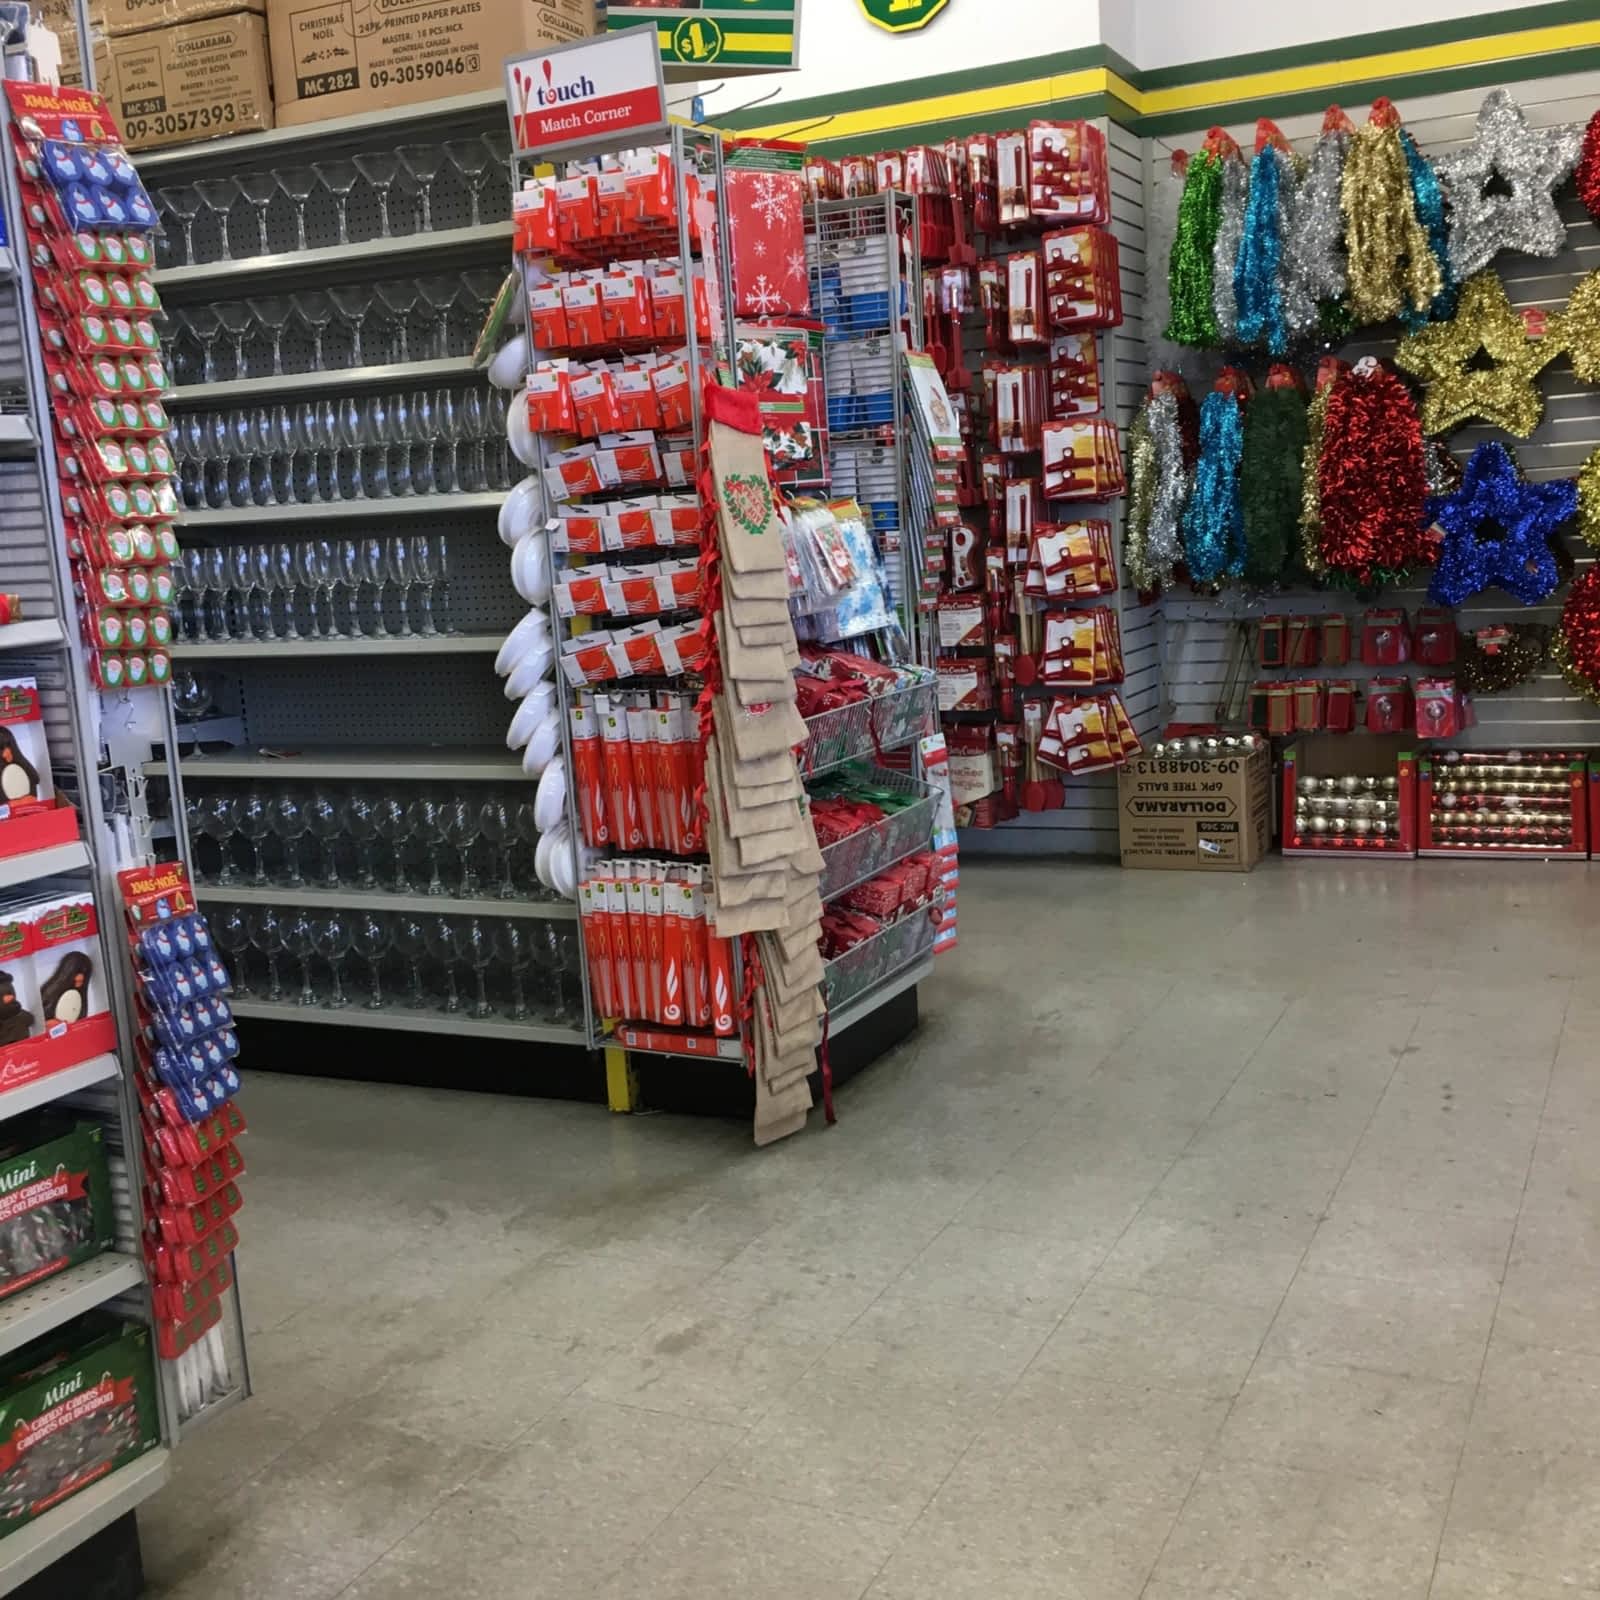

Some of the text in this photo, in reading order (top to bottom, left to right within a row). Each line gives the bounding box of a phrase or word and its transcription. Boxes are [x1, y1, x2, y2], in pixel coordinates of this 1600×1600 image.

[299, 13, 345, 32] CHRISTMAS
[384, 13, 420, 29] PRINTED
[422, 8, 449, 21] PAPER
[450, 2, 481, 16] PLATES
[177, 34, 232, 53] DOLLARAMA
[304, 73, 354, 96] MC 282
[370, 56, 465, 88] 09-3059046
[537, 74, 595, 106] touch
[126, 103, 141, 115] MC
[126, 102, 235, 140] 09-3057393
[540, 105, 632, 135] Match Corner
[1137, 760, 1239, 774] 09-3048813
[1138, 782, 1223, 792] 6PK TREE BALLS
[1135, 801, 1226, 813] DOLLARAMA
[0, 1160, 38, 1192] Mini
[42, 1371, 82, 1411] Mini
